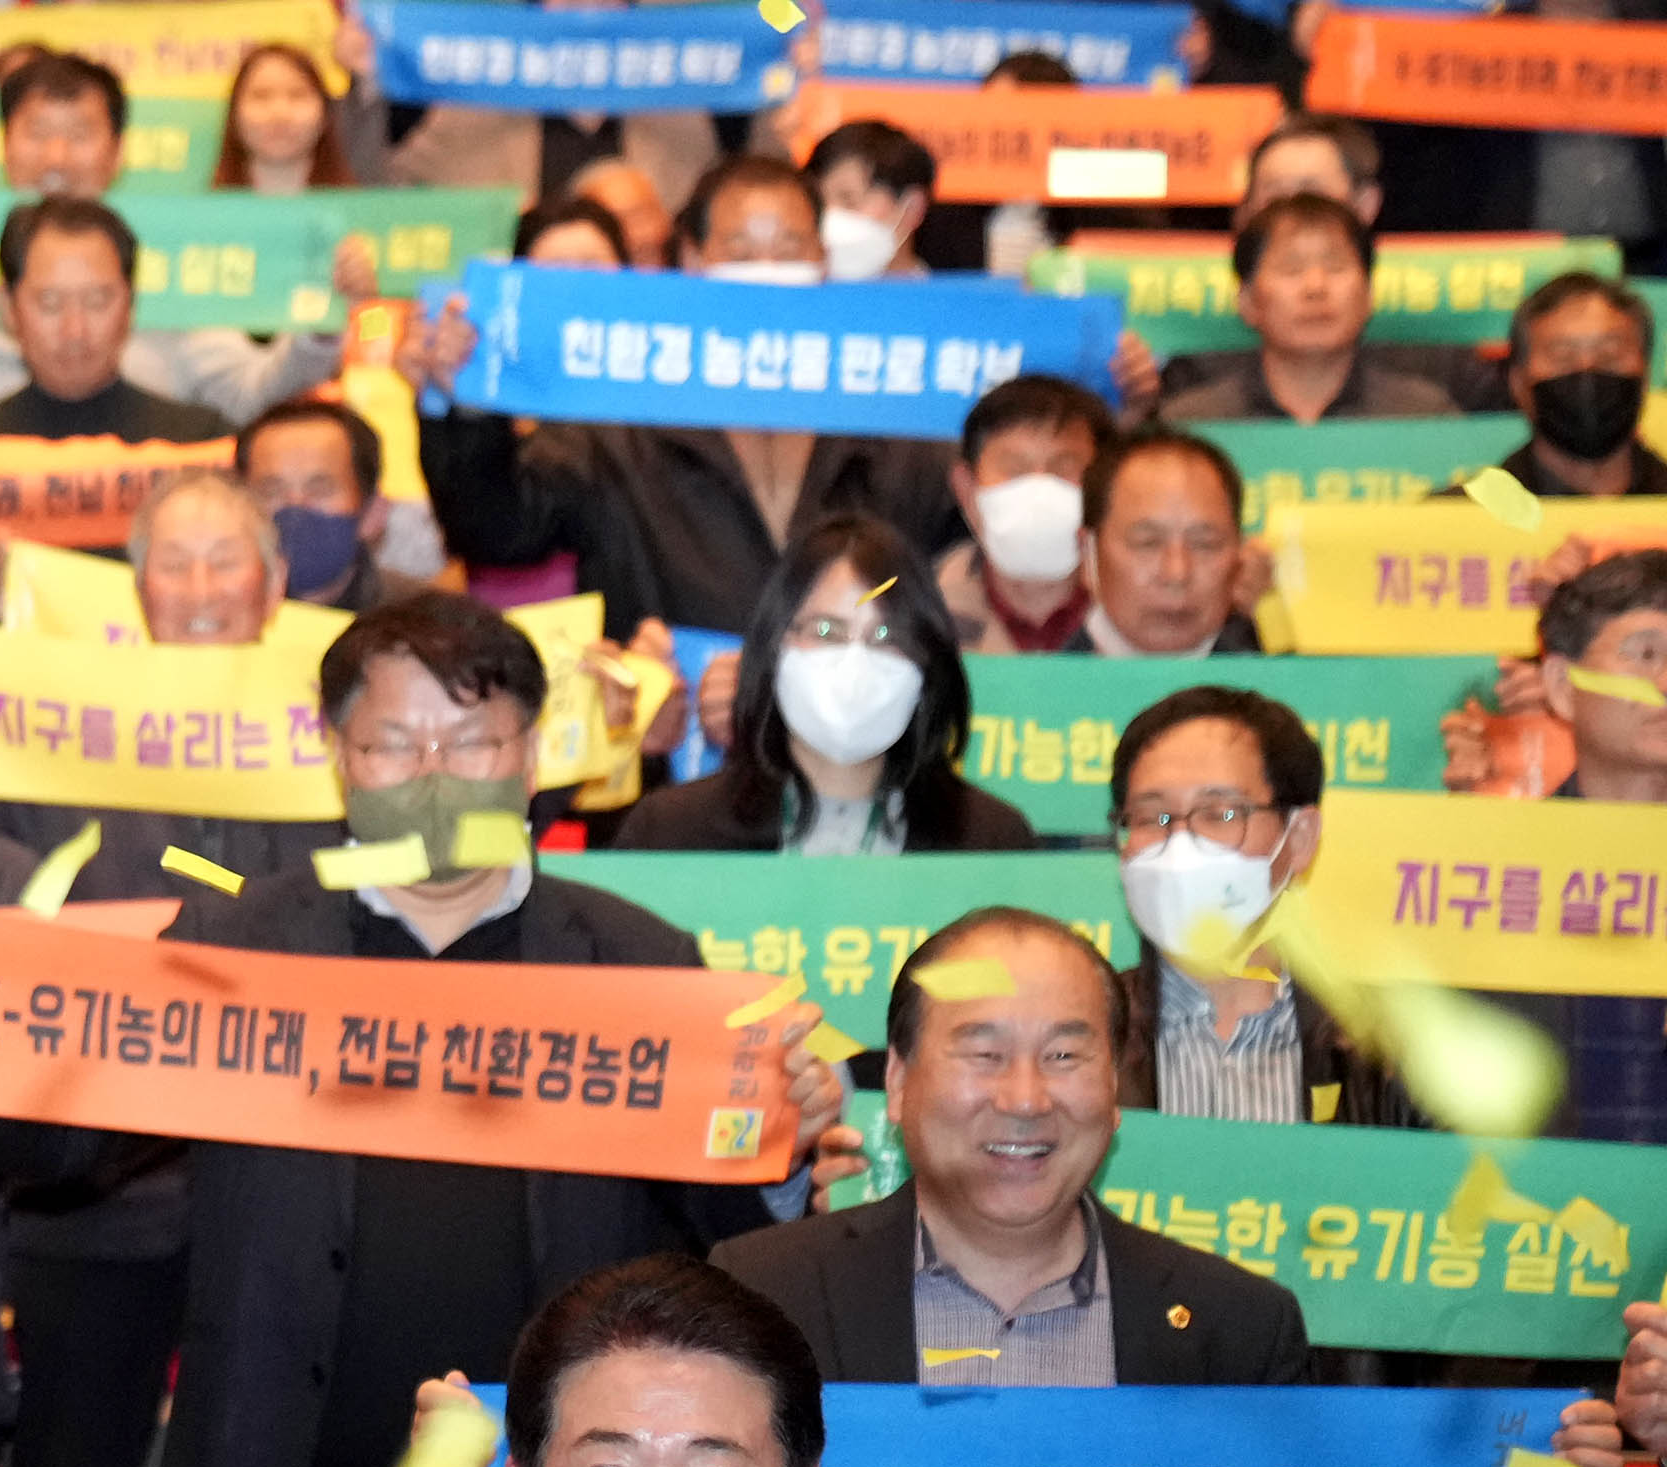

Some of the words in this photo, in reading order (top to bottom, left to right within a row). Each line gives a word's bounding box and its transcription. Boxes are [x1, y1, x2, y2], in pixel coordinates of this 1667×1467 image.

[562, 317, 692, 385] 친환경
[702, 327, 831, 391] 농산물
[839, 332, 926, 395] 판로
[1374, 552, 1490, 609] 지구를
[134, 709, 270, 770] 살리는
[1394, 860, 1542, 933] 지구를
[216, 998, 321, 1096] 미래,
[334, 1014, 429, 1091] 전남
[439, 1025, 673, 1111] 친환경농업
